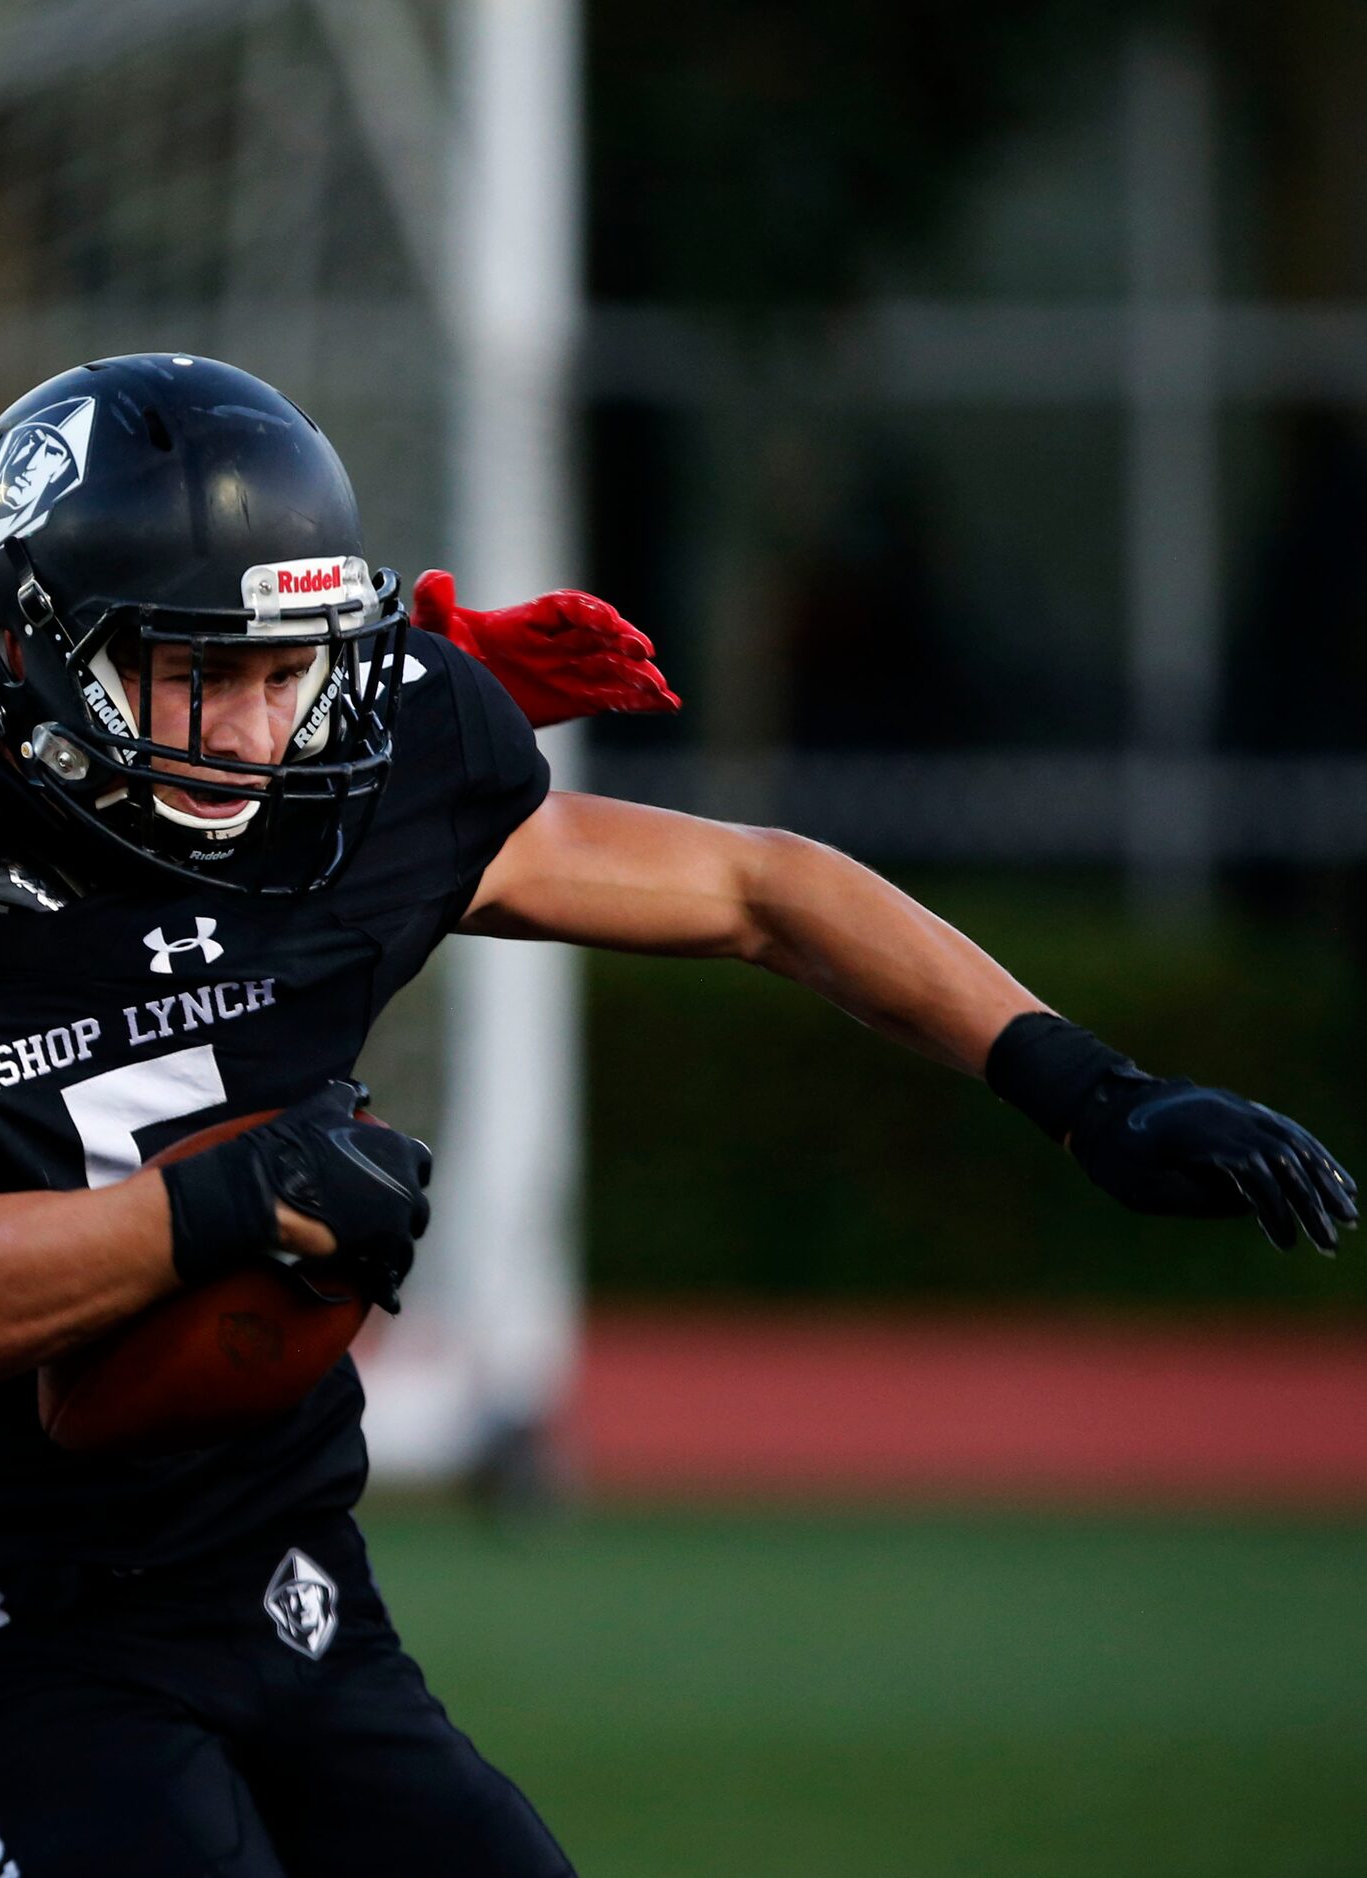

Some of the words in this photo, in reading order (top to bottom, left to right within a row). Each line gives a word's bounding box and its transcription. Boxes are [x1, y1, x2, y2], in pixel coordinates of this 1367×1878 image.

[277, 564, 341, 593] Riddell
[293, 666, 344, 749] Riddell
[189, 848, 235, 861] Riddell
[122, 978, 276, 1046] LYNCH
